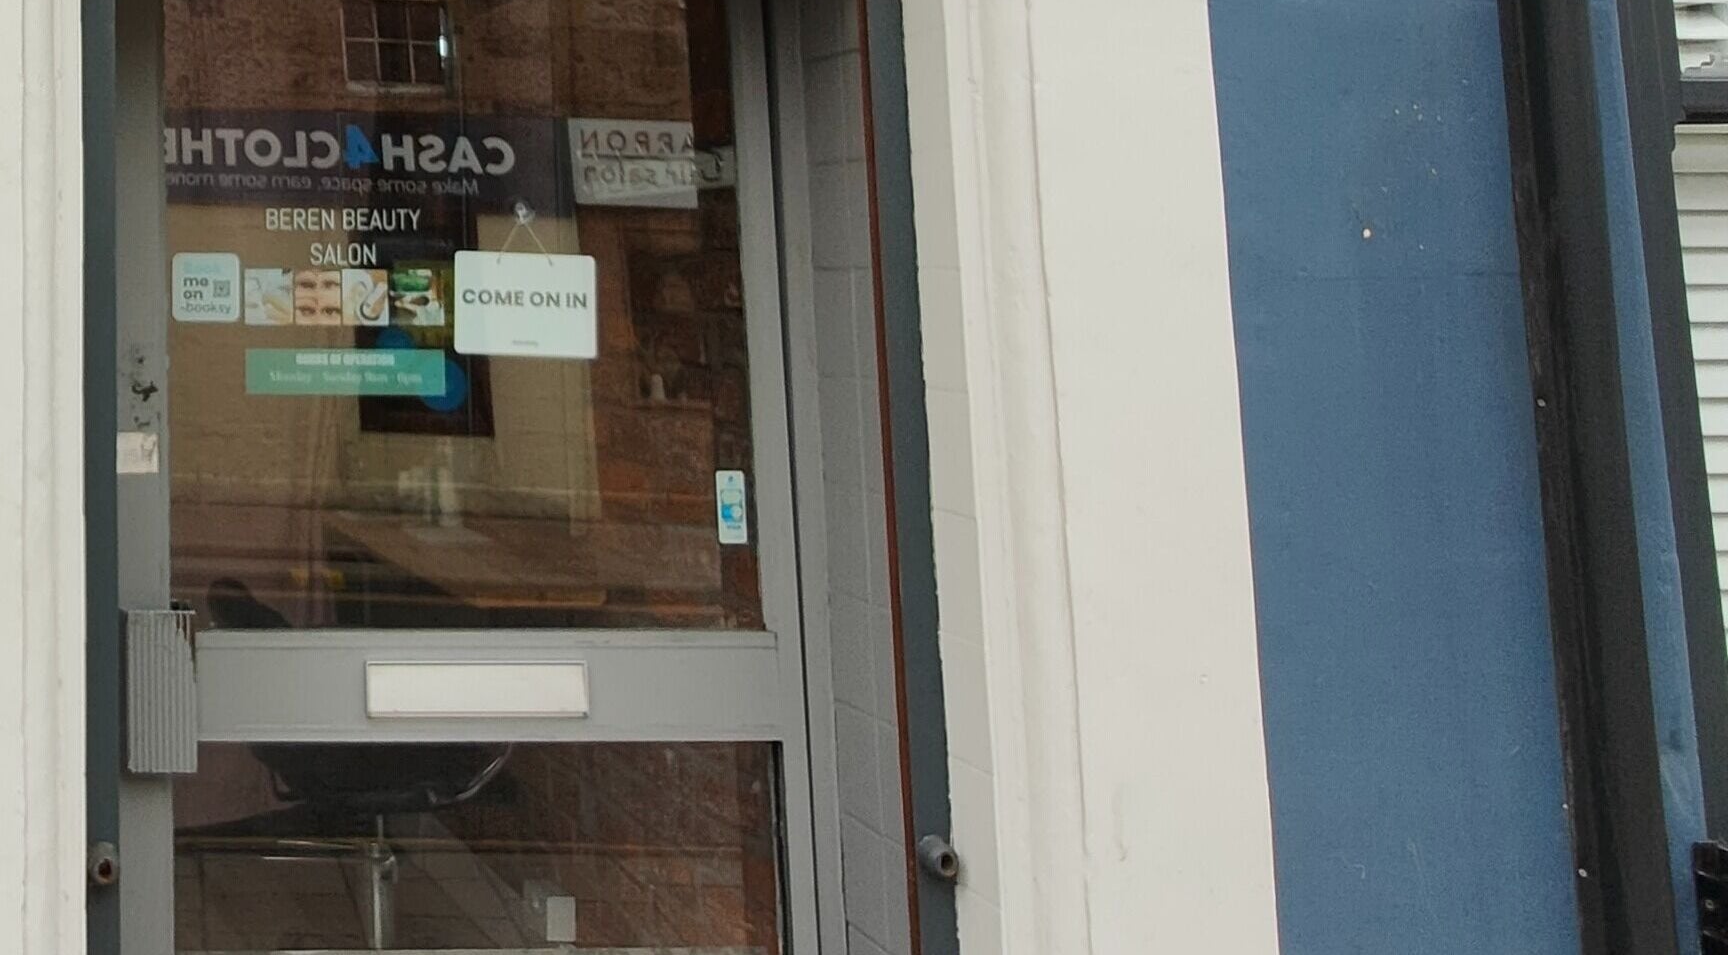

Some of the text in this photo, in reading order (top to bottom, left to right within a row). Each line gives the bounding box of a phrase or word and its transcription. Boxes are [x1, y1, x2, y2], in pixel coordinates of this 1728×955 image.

[265, 207, 421, 231] BEREN BEAUTY
[310, 243, 376, 266] SALON
[462, 289, 588, 309] COME ON IN
